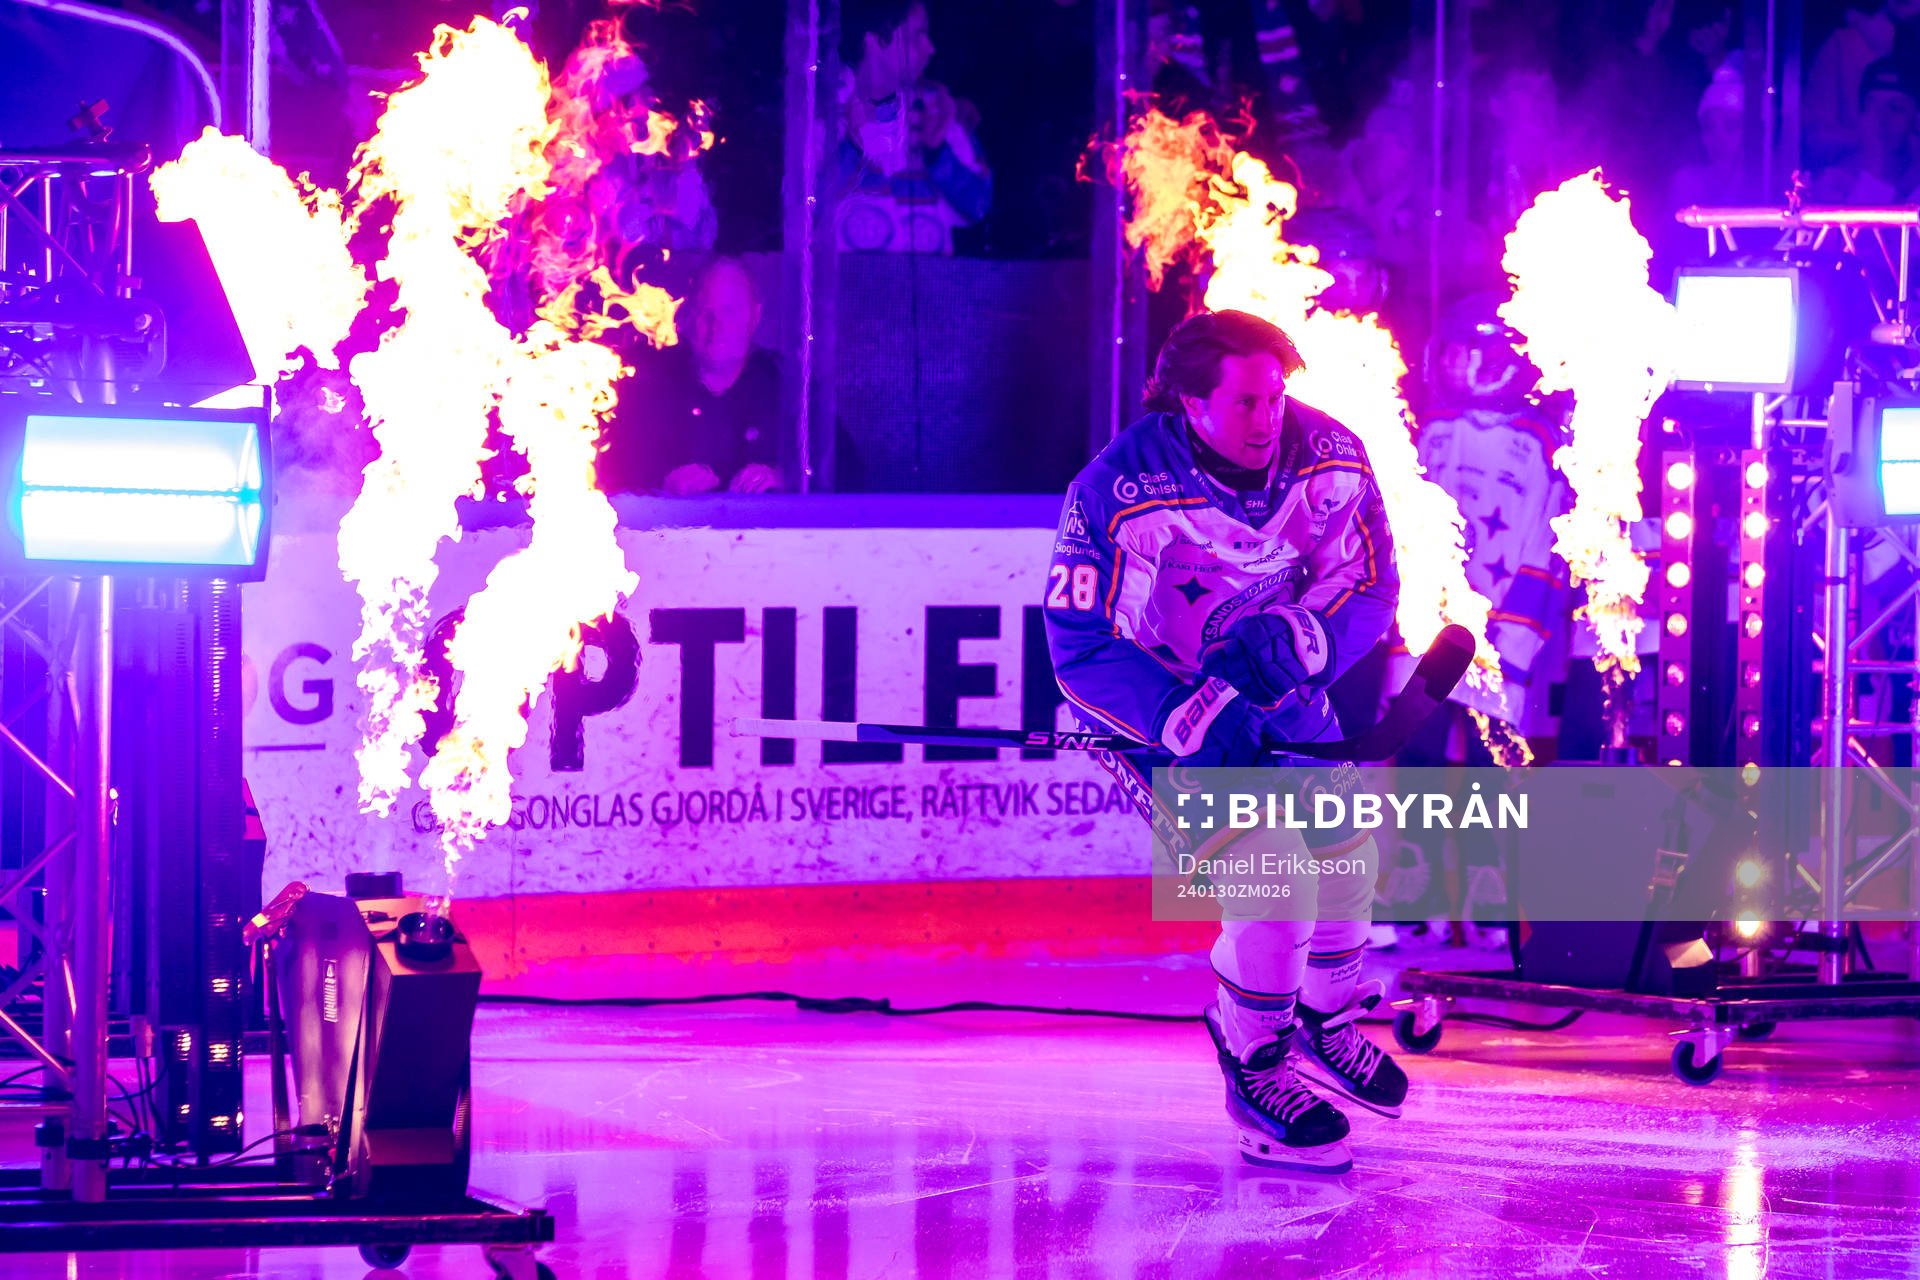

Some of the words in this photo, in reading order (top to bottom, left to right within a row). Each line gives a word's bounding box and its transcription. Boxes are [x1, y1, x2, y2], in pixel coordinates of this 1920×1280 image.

[1138, 472, 1168, 484] Clas
[1143, 483, 1184, 496] Ohlson
[1066, 516, 1086, 536] NS
[1047, 563, 1098, 612] 28
[1025, 731, 1113, 751] SYNC
[775, 788, 783, 823] I
[789, 785, 914, 824] SVERIGE,
